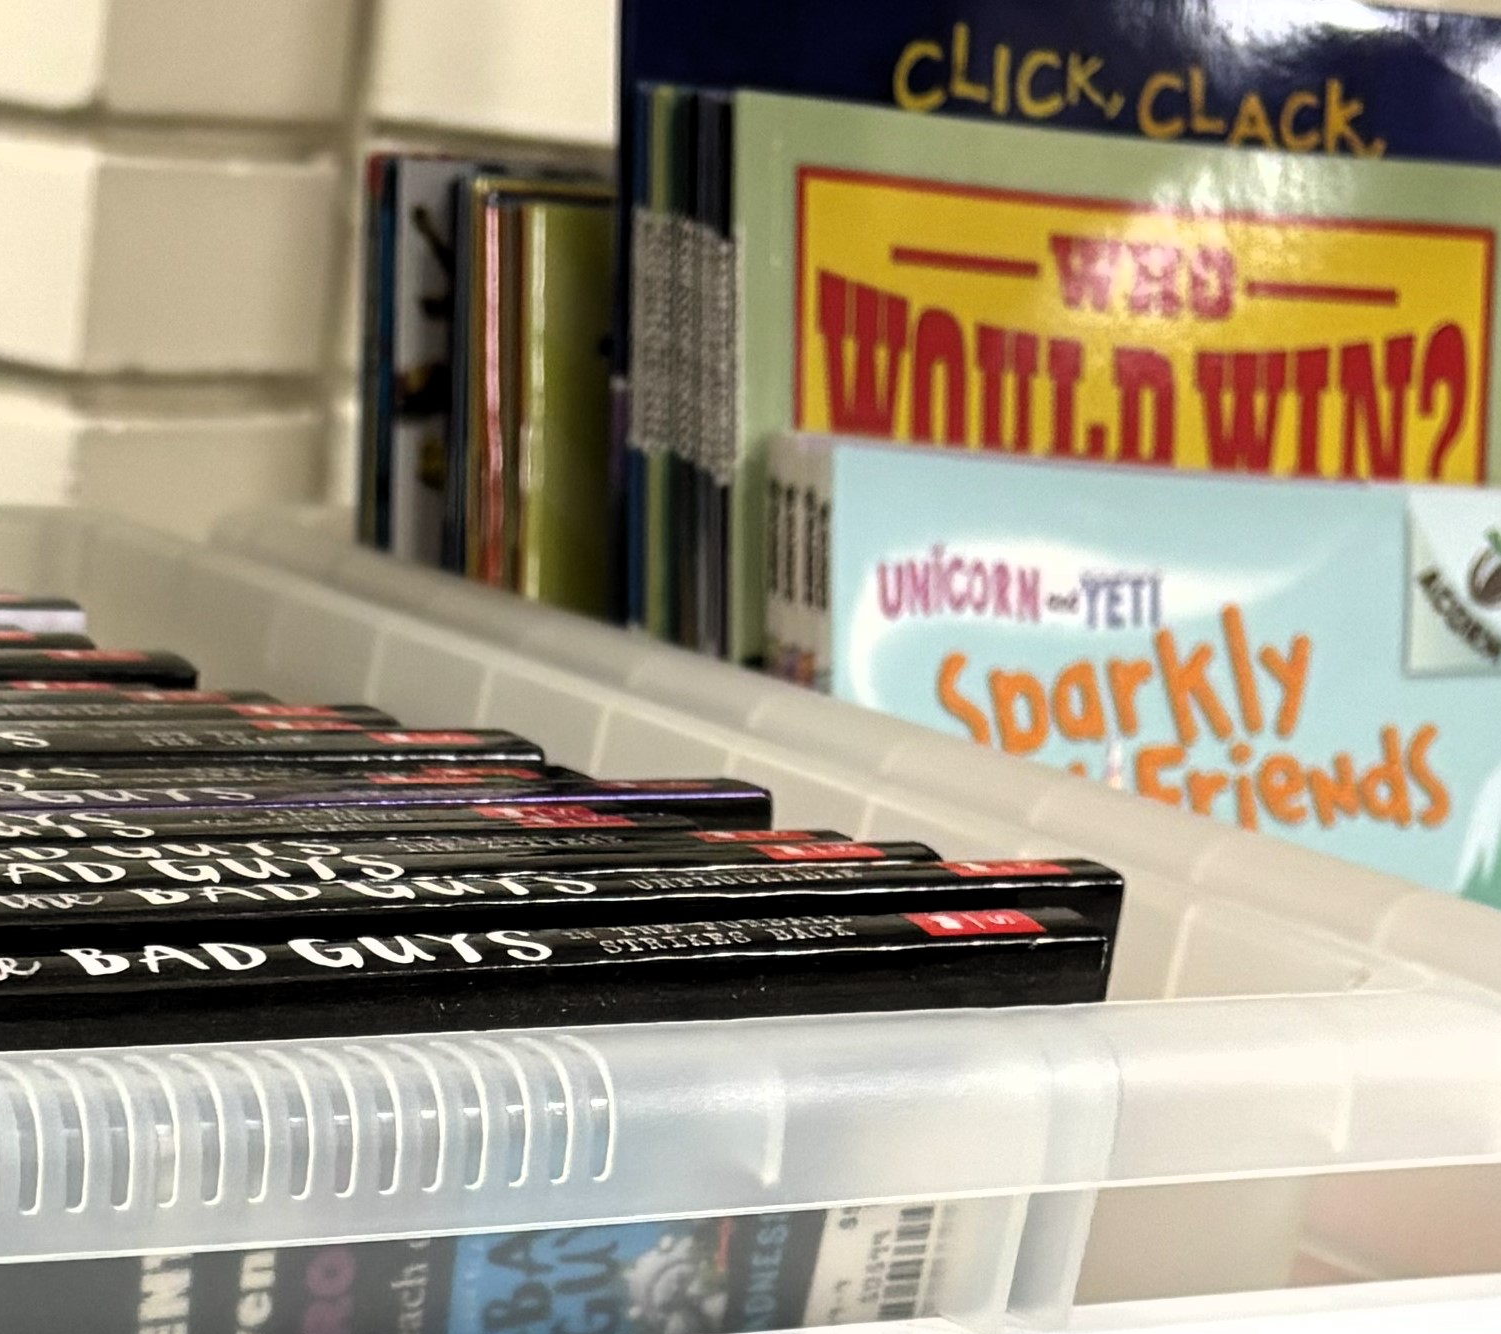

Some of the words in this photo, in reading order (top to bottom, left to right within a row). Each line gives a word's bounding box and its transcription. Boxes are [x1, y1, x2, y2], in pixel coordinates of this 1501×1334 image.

[893, 22, 1125, 118] CLICK,
[1138, 74, 1386, 157] CLACK,
[1049, 232, 1236, 321] WHO
[817, 268, 1176, 468] WOULD
[1194, 320, 1467, 486] WIN?
[1081, 570, 1164, 630] YETI
[936, 604, 1312, 754] Sparkly
[92, 840, 342, 860] GUYS
[147, 854, 405, 883] GUYS
[126, 882, 323, 905] BAD
[343, 872, 597, 899] GUYS
[61, 942, 268, 976] BAD
[287, 929, 552, 969] GUYS
[599, 931, 752, 955] STRIKES
[764, 923, 857, 942] BACK
